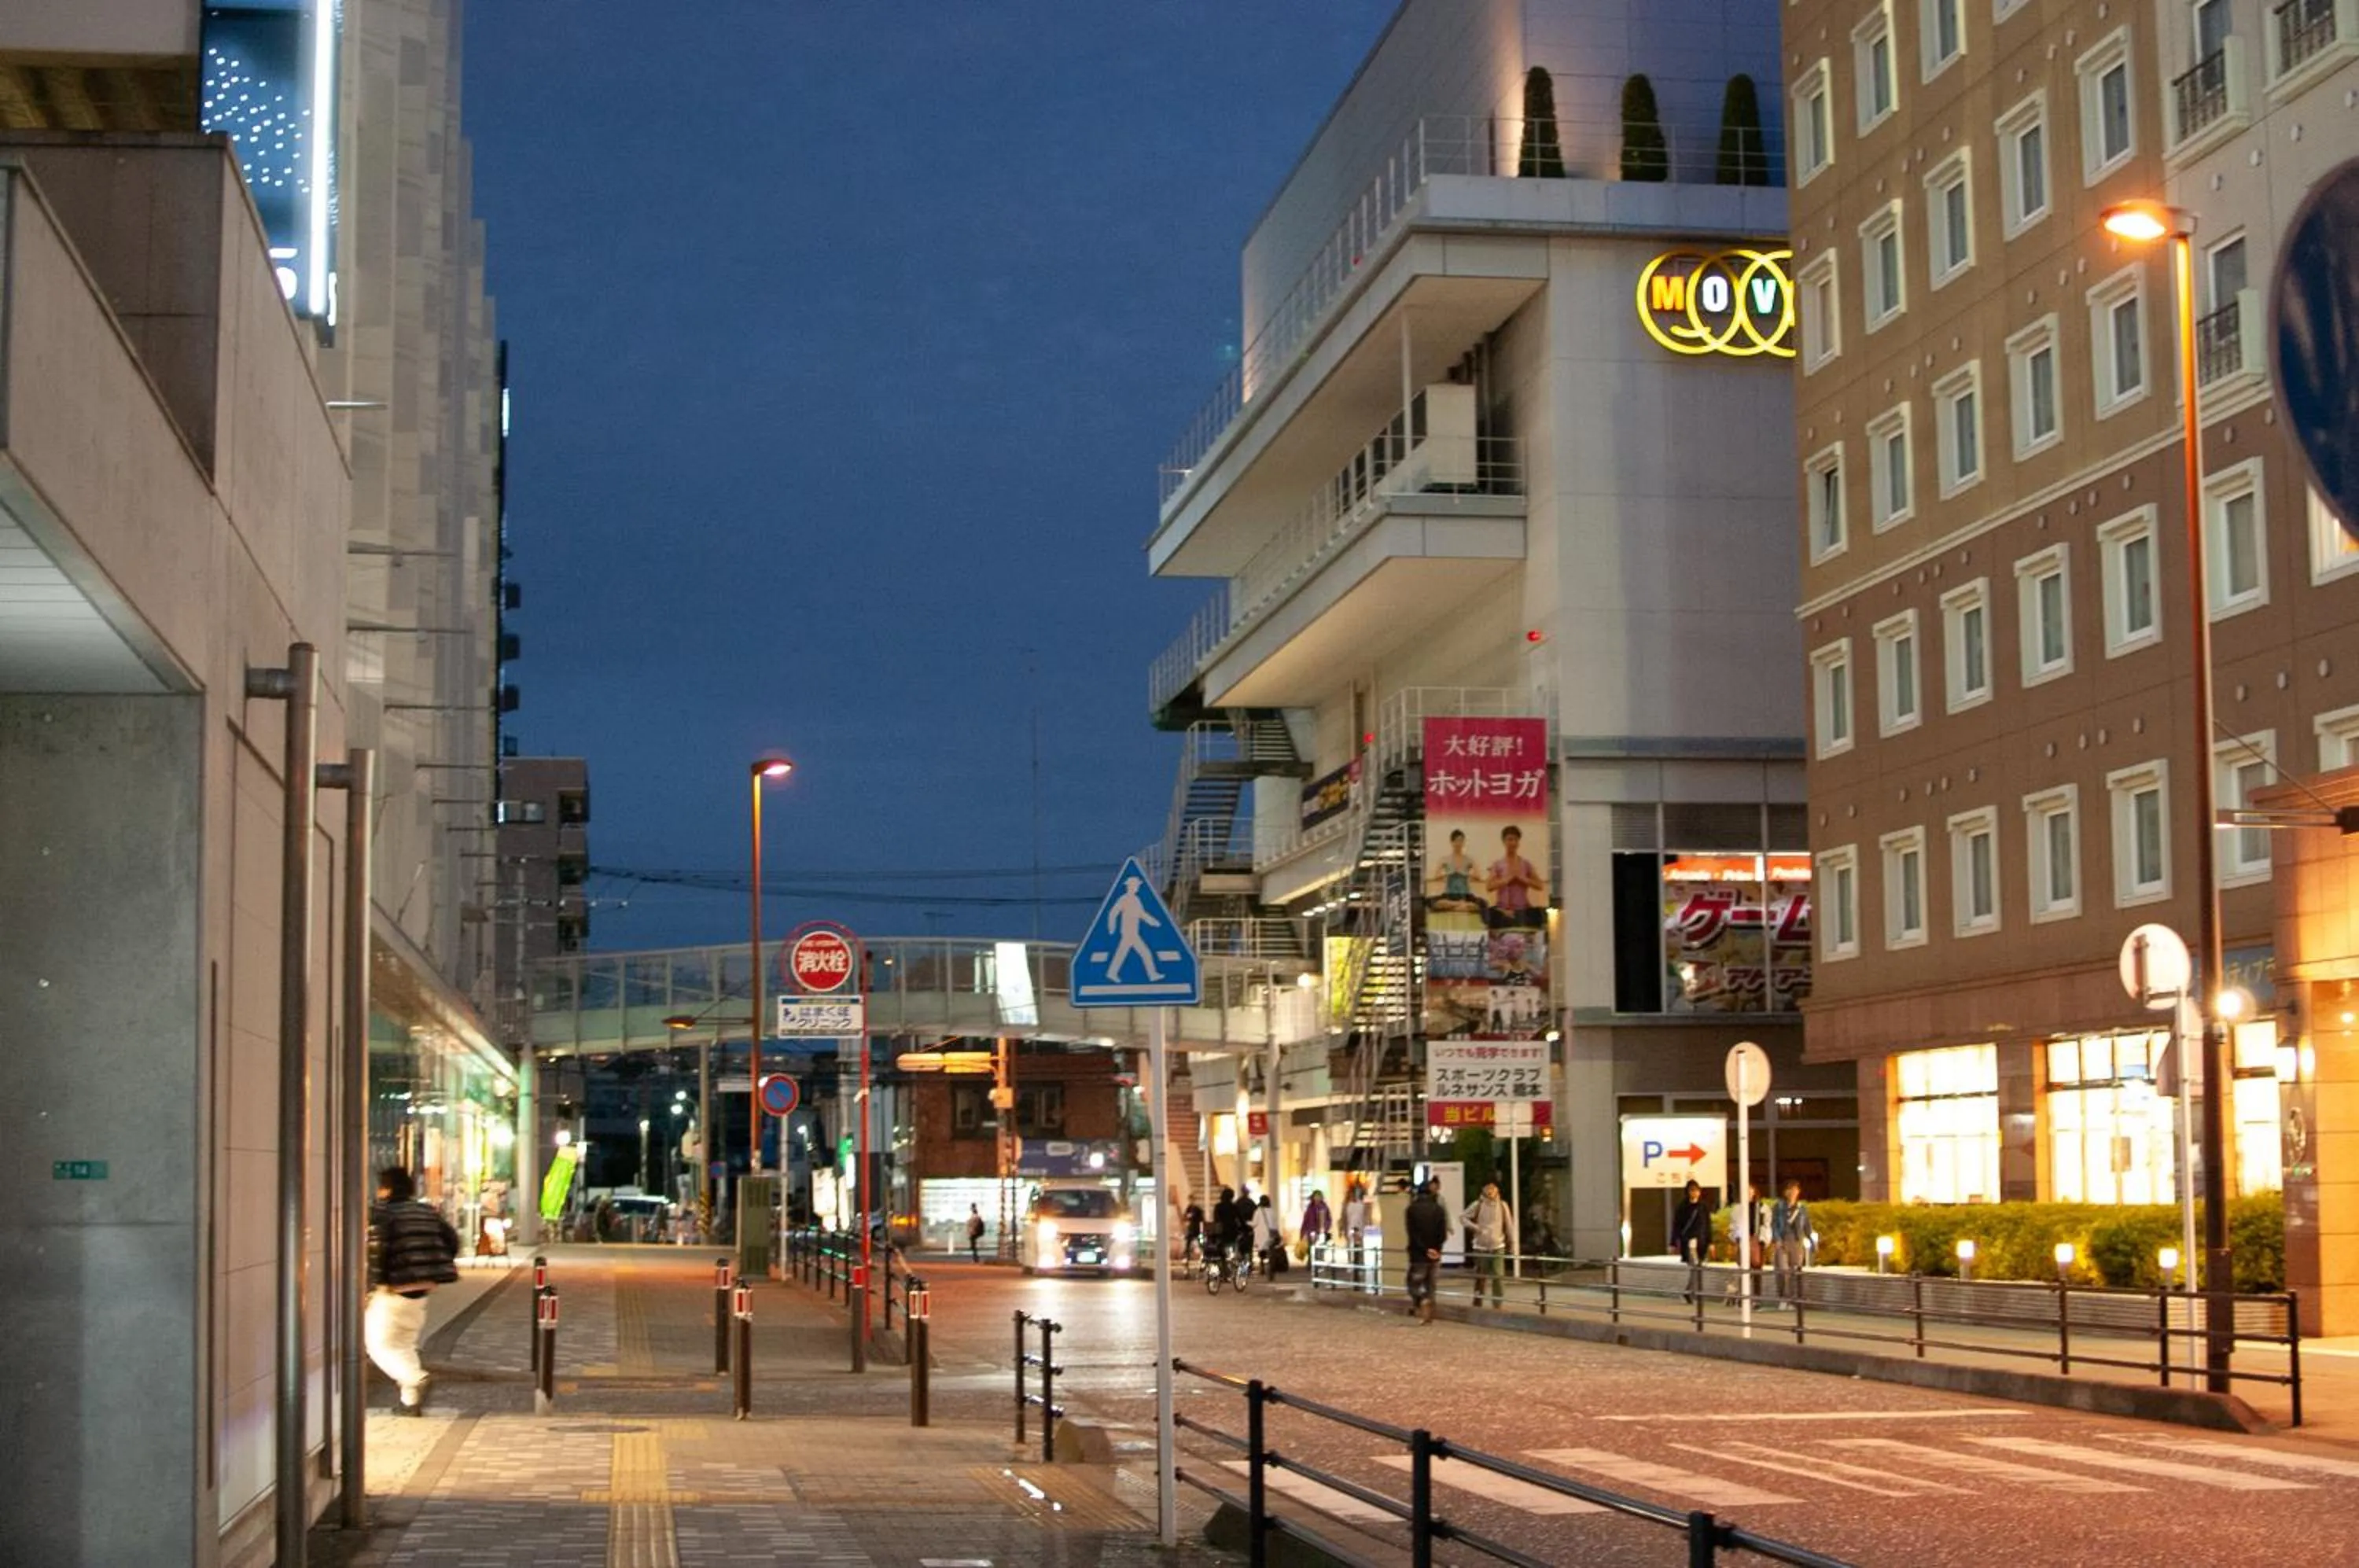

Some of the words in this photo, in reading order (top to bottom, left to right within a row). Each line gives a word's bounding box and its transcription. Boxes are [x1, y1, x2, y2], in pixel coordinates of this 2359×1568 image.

[1651, 276, 1777, 315] MOV
[1444, 734, 1524, 757] 大好評!
[1427, 768, 1545, 799] ホットヨガ
[798, 949, 847, 974] 消火栓
[1436, 1067, 1542, 1082] スポーツクラブ
[1436, 1082, 1508, 1098] ルネサンス
[1643, 1141, 1663, 1168] P
